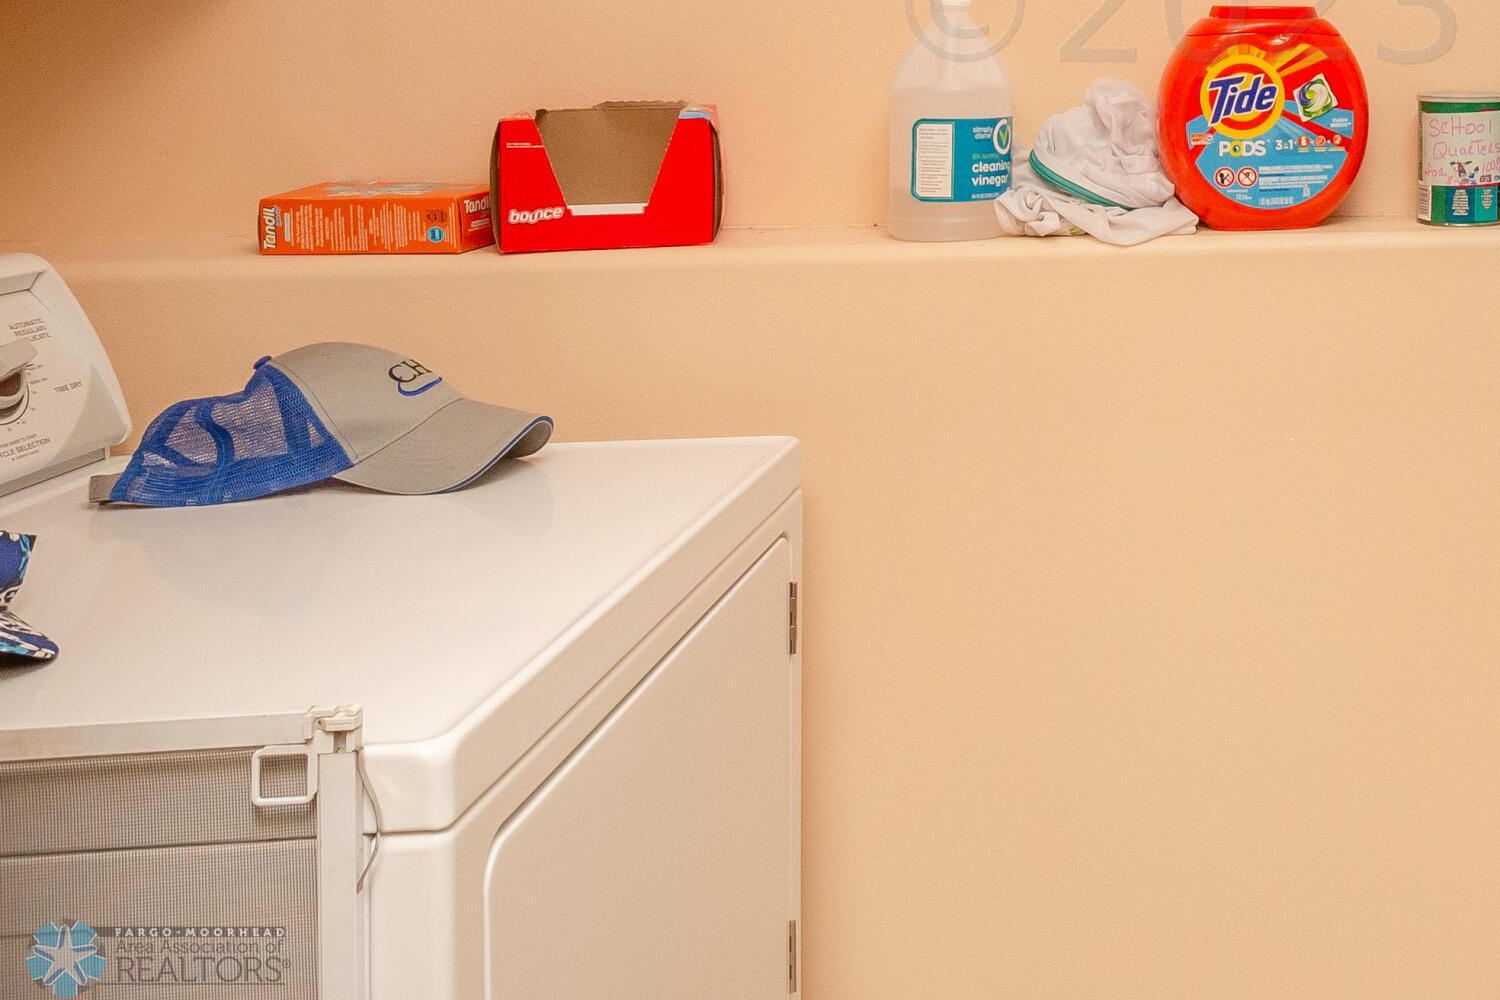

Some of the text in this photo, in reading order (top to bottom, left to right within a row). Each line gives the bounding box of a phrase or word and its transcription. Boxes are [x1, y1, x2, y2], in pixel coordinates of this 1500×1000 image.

[1208, 73, 1279, 127] Tide
[1218, 140, 1267, 157] PODS
[972, 160, 1011, 173] cleaning
[971, 174, 1009, 187] vinegar
[508, 206, 565, 225] bounce
[262, 205, 277, 250] Tandil
[18, 437, 51, 454] SELECTION
